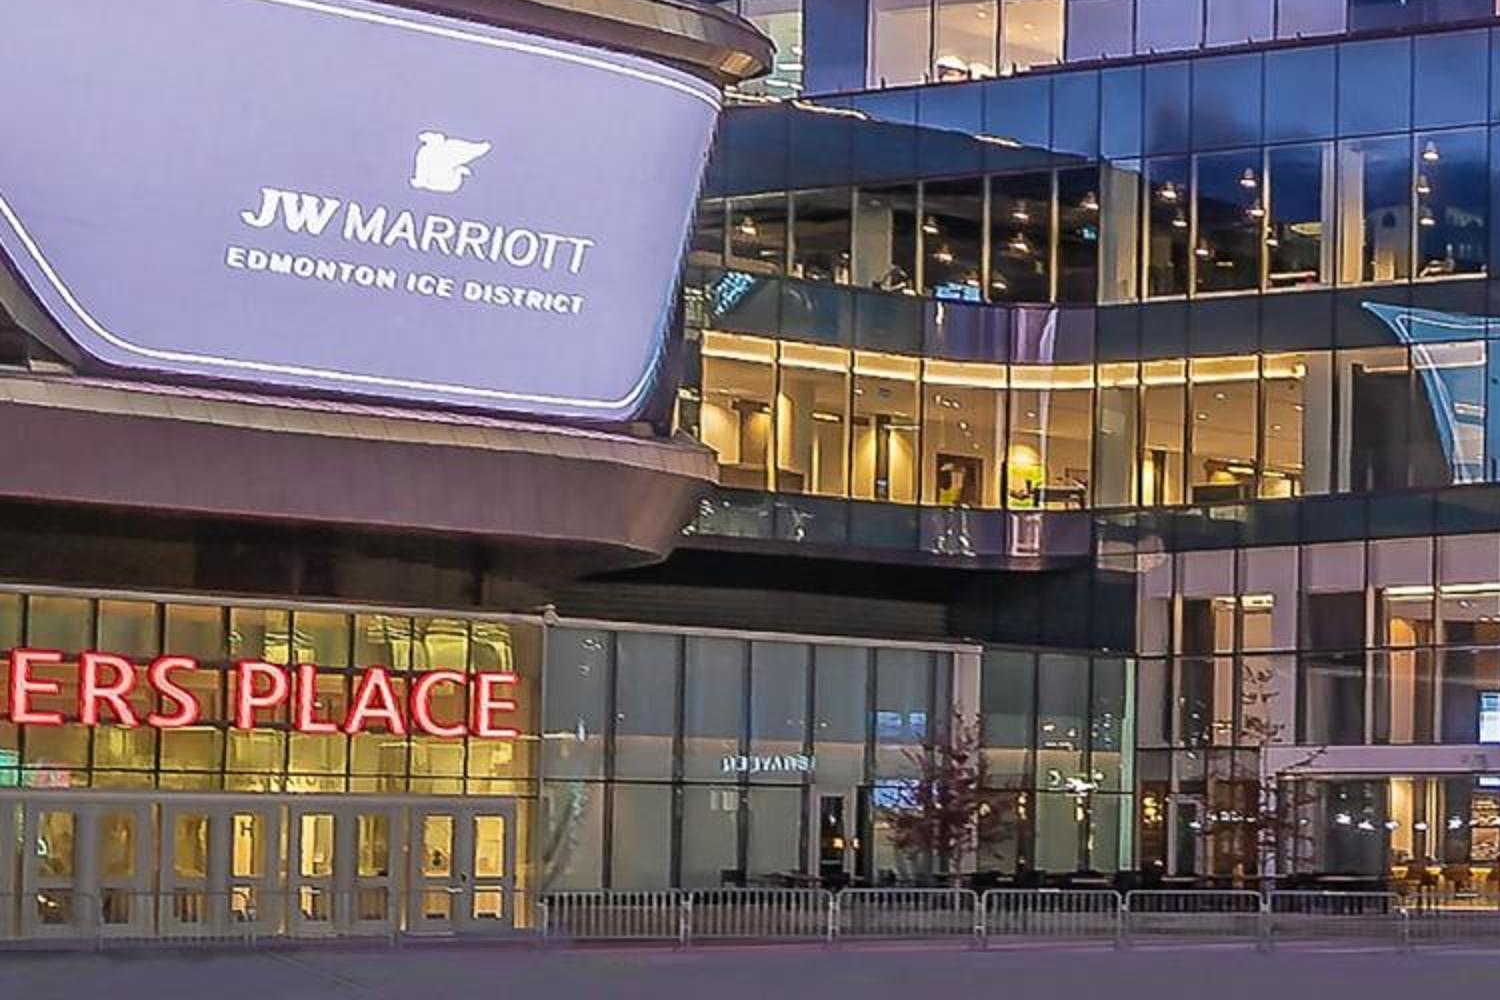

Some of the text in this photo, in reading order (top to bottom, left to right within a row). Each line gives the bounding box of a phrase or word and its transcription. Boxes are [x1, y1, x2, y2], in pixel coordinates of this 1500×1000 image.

[241, 187, 595, 274] JW MARRIOTT
[226, 247, 584, 314] EDMONTON ICE DISTRICT
[8, 647, 521, 739] ERS PLACE
